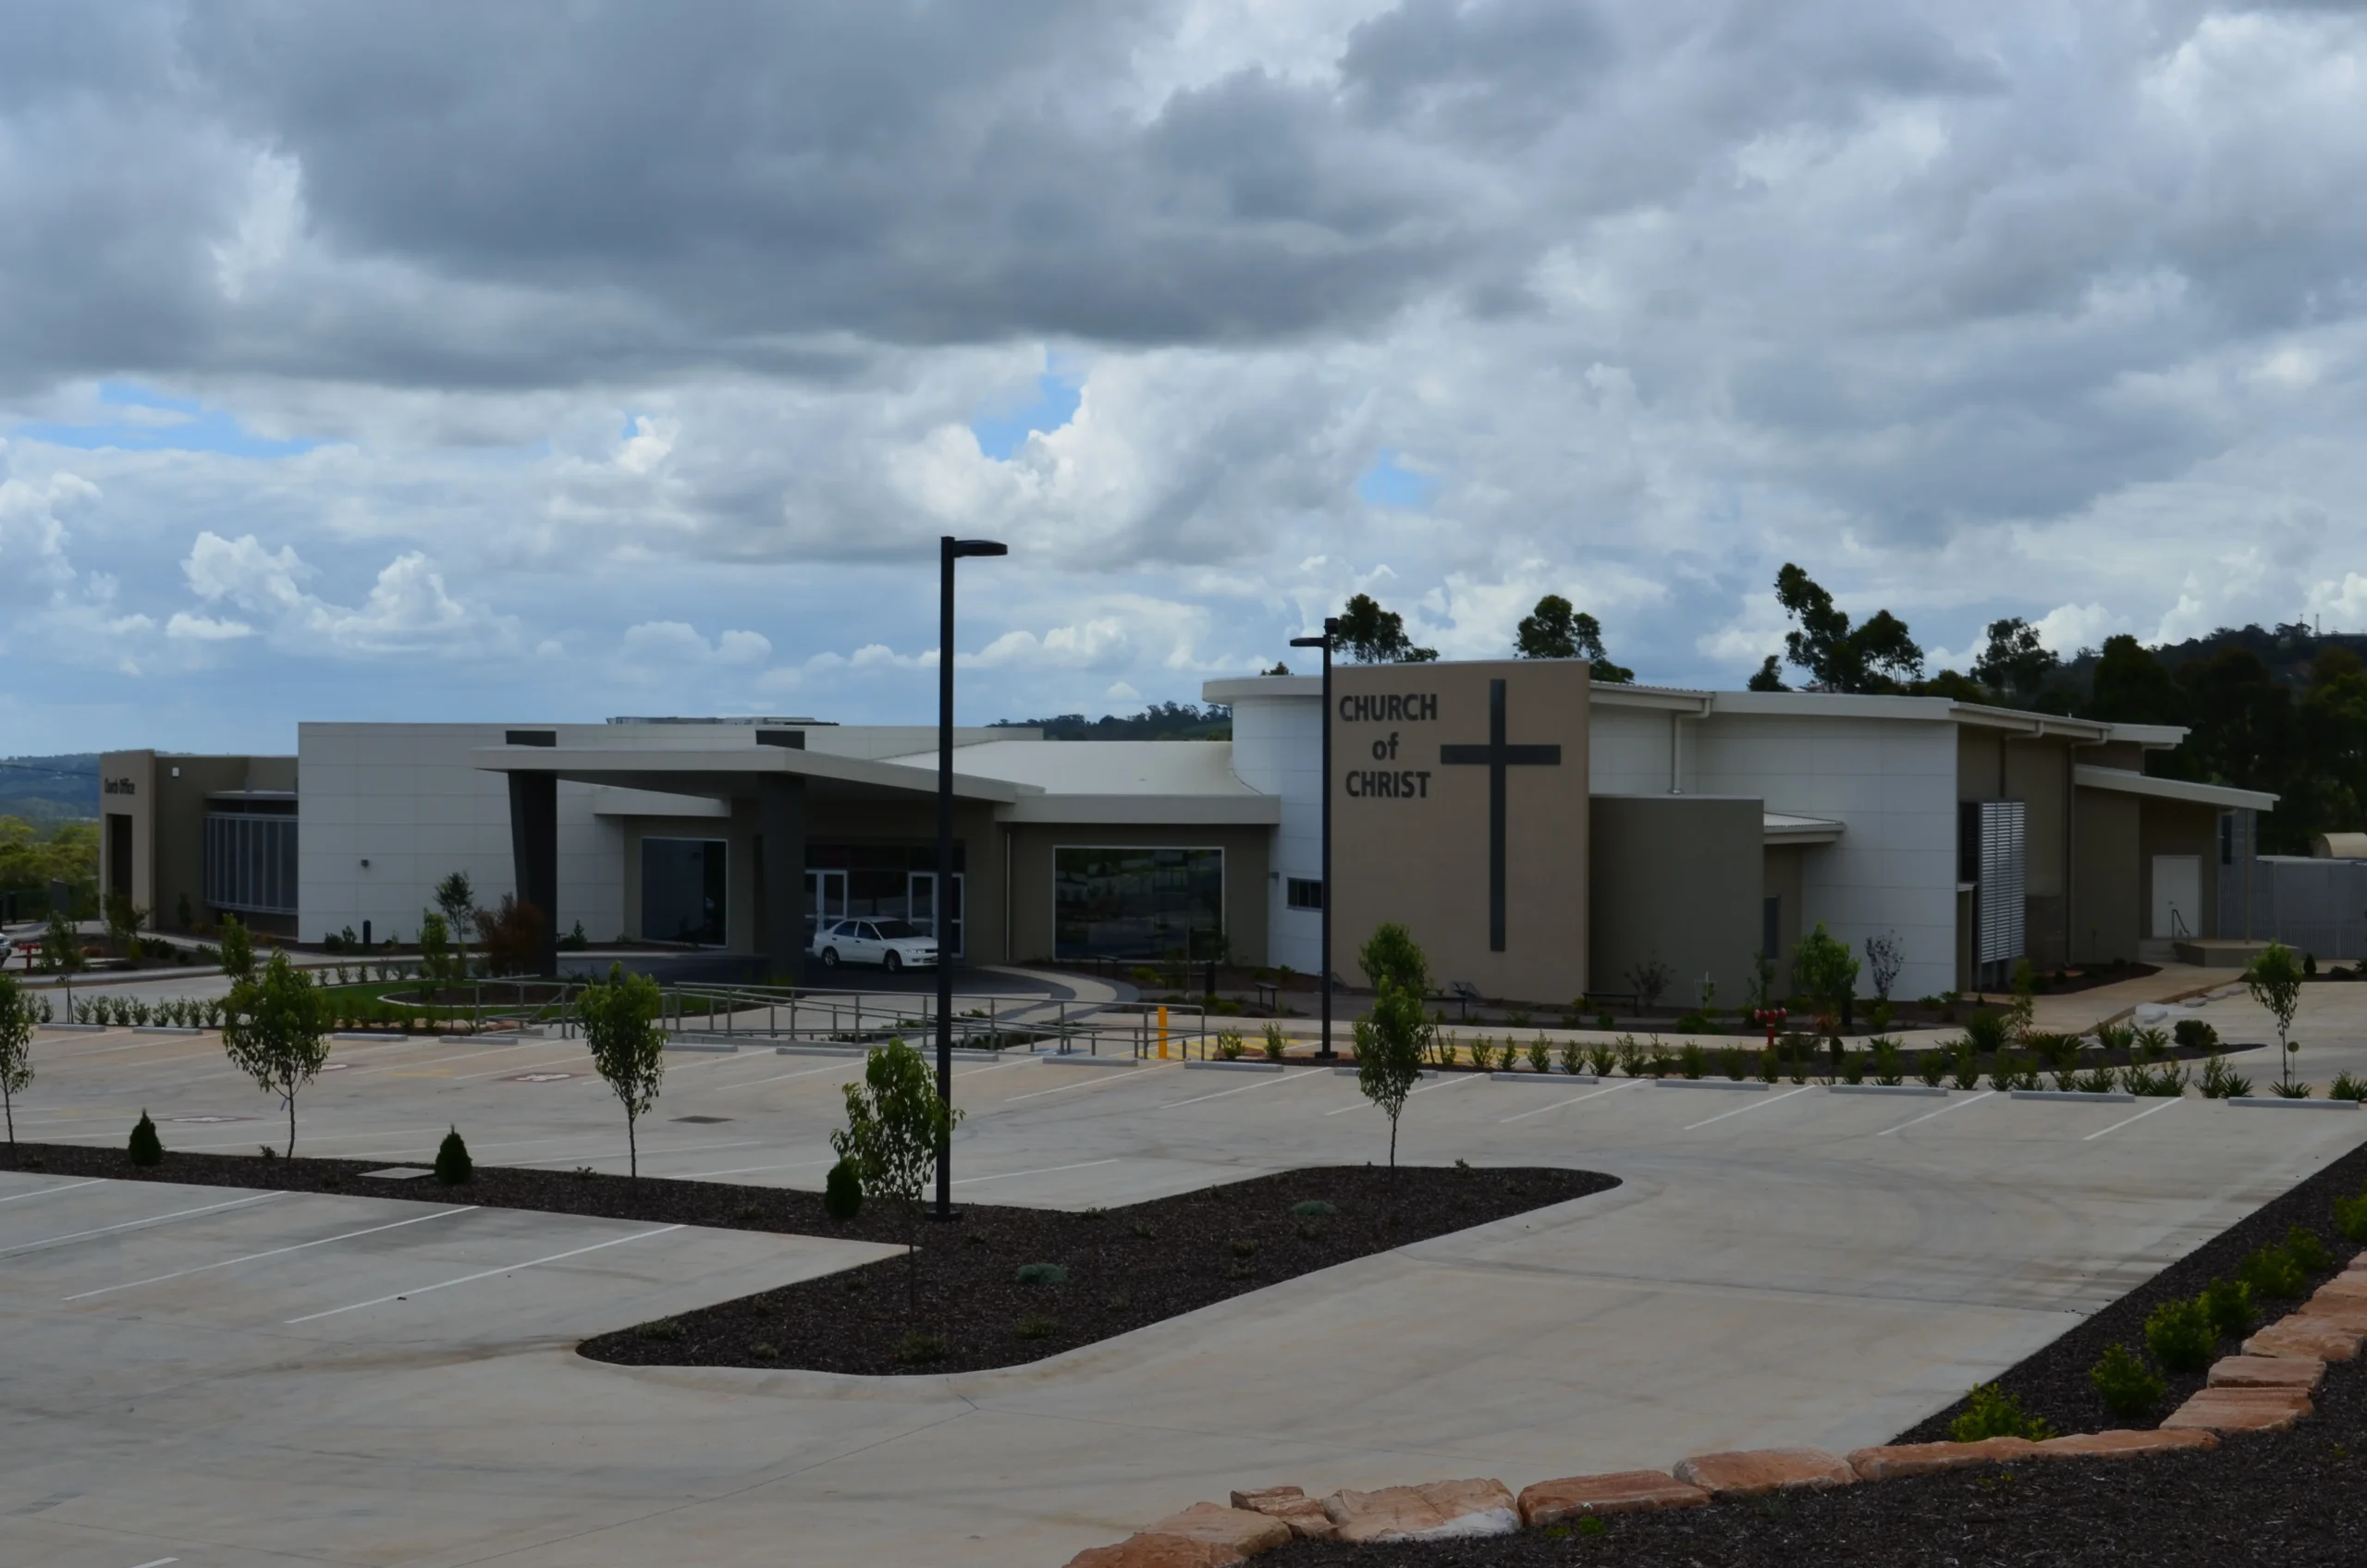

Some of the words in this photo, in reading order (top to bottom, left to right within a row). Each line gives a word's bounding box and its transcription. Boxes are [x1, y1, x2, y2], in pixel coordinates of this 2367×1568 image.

[1340, 693, 1438, 722] CHURCH
[1372, 731, 1399, 761] of
[1345, 770, 1431, 799] CHRIST
